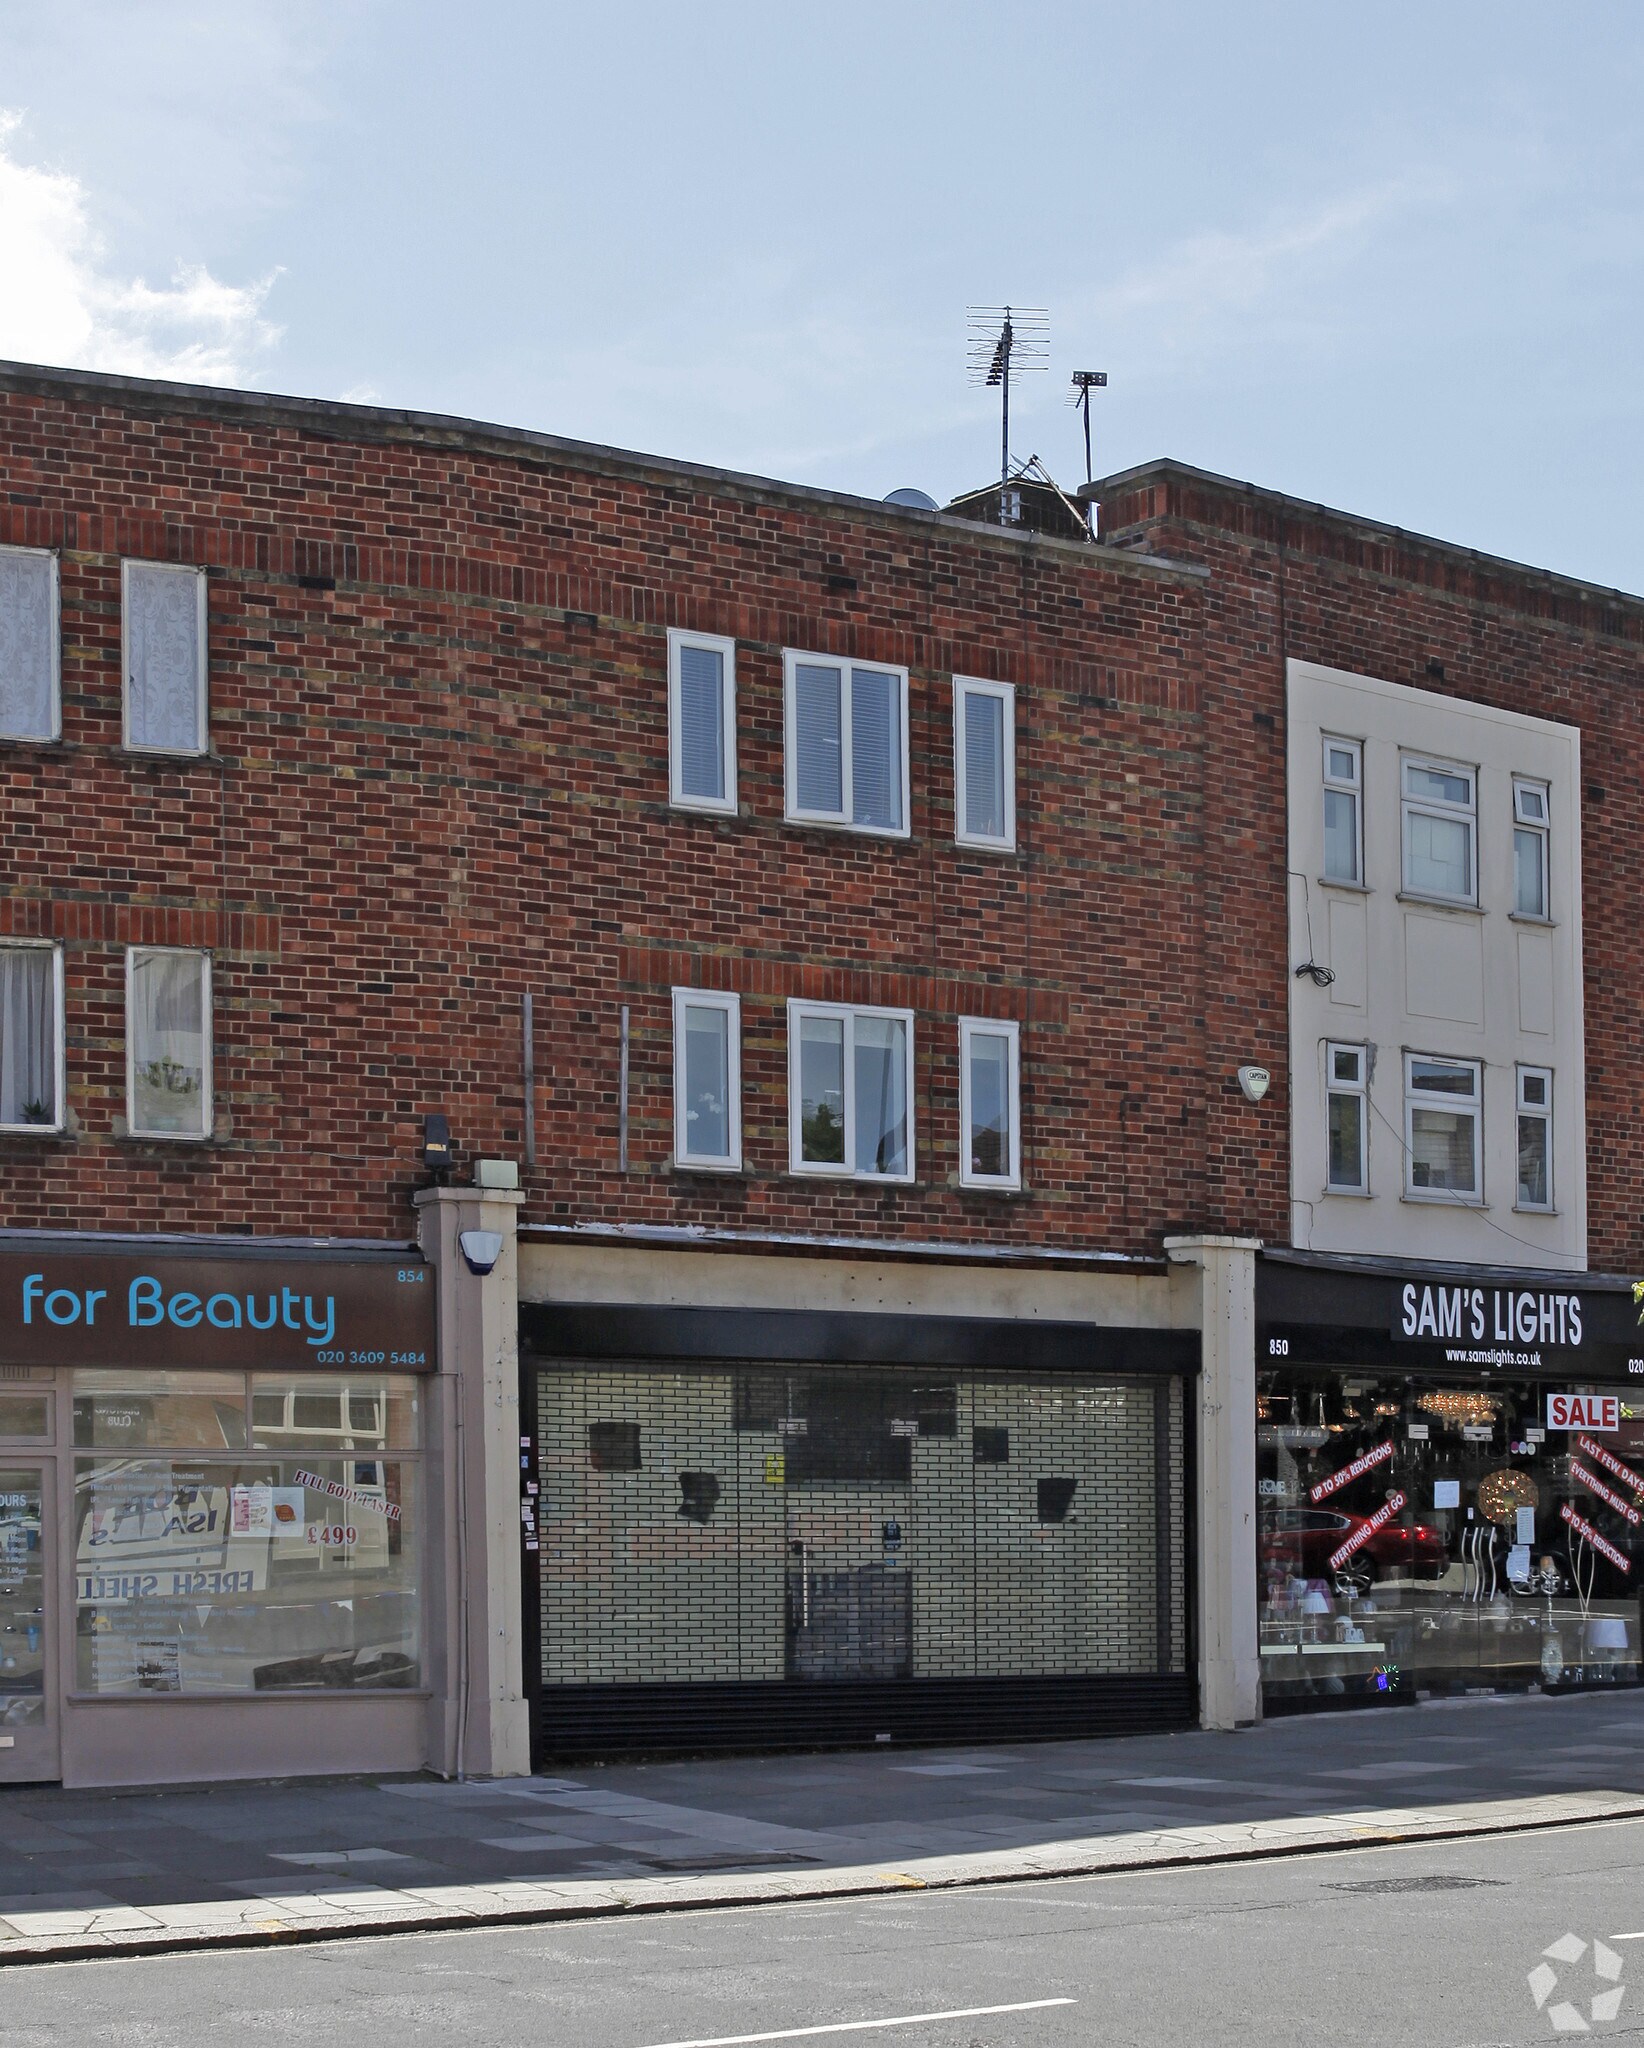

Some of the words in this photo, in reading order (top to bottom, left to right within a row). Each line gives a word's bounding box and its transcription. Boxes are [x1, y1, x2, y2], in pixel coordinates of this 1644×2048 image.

[397, 1270, 425, 1283] 854
[22, 1273, 108, 1326] for
[128, 1275, 335, 1346] Beauty
[1402, 1283, 1485, 1340] SAM'S
[1494, 1290, 1583, 1346] LIGHTS
[317, 1351, 345, 1364] 020
[349, 1351, 385, 1364] 3609
[390, 1352, 426, 1365] 5484
[1269, 1339, 1289, 1355] 850
[1446, 1348, 1542, 1367] www.samslights.co.uk
[1628, 1359, 1644, 1374] 020
[1553, 1396, 1617, 1427] SALE
[1312, 1486, 1323, 1500] UP
[1322, 1479, 1334, 1493] TO
[1334, 1470, 1351, 1487] 50%
[1349, 1442, 1392, 1477] REDUCTIONS
[1580, 1436, 1601, 1458] LAST
[1601, 1452, 1621, 1473] FEW
[1621, 1468, 1644, 1492] DAYS
[295, 1470, 324, 1491] FULL
[326, 1482, 361, 1502] BODY
[361, 1495, 400, 1518] LASER
[1571, 1462, 1610, 1499] EVERYTHING
[1609, 1494, 1628, 1514] MUST
[1627, 1509, 1639, 1523] GO
[307, 1526, 357, 1544] £499
[1330, 1524, 1372, 1569] EVERYTHING
[1370, 1505, 1392, 1529] MUST
[1390, 1494, 1404, 1510] GO
[1562, 1506, 1572, 1519] UP
[1571, 1514, 1580, 1527] TO
[1593, 1534, 1629, 1570] REDUCTIONS
